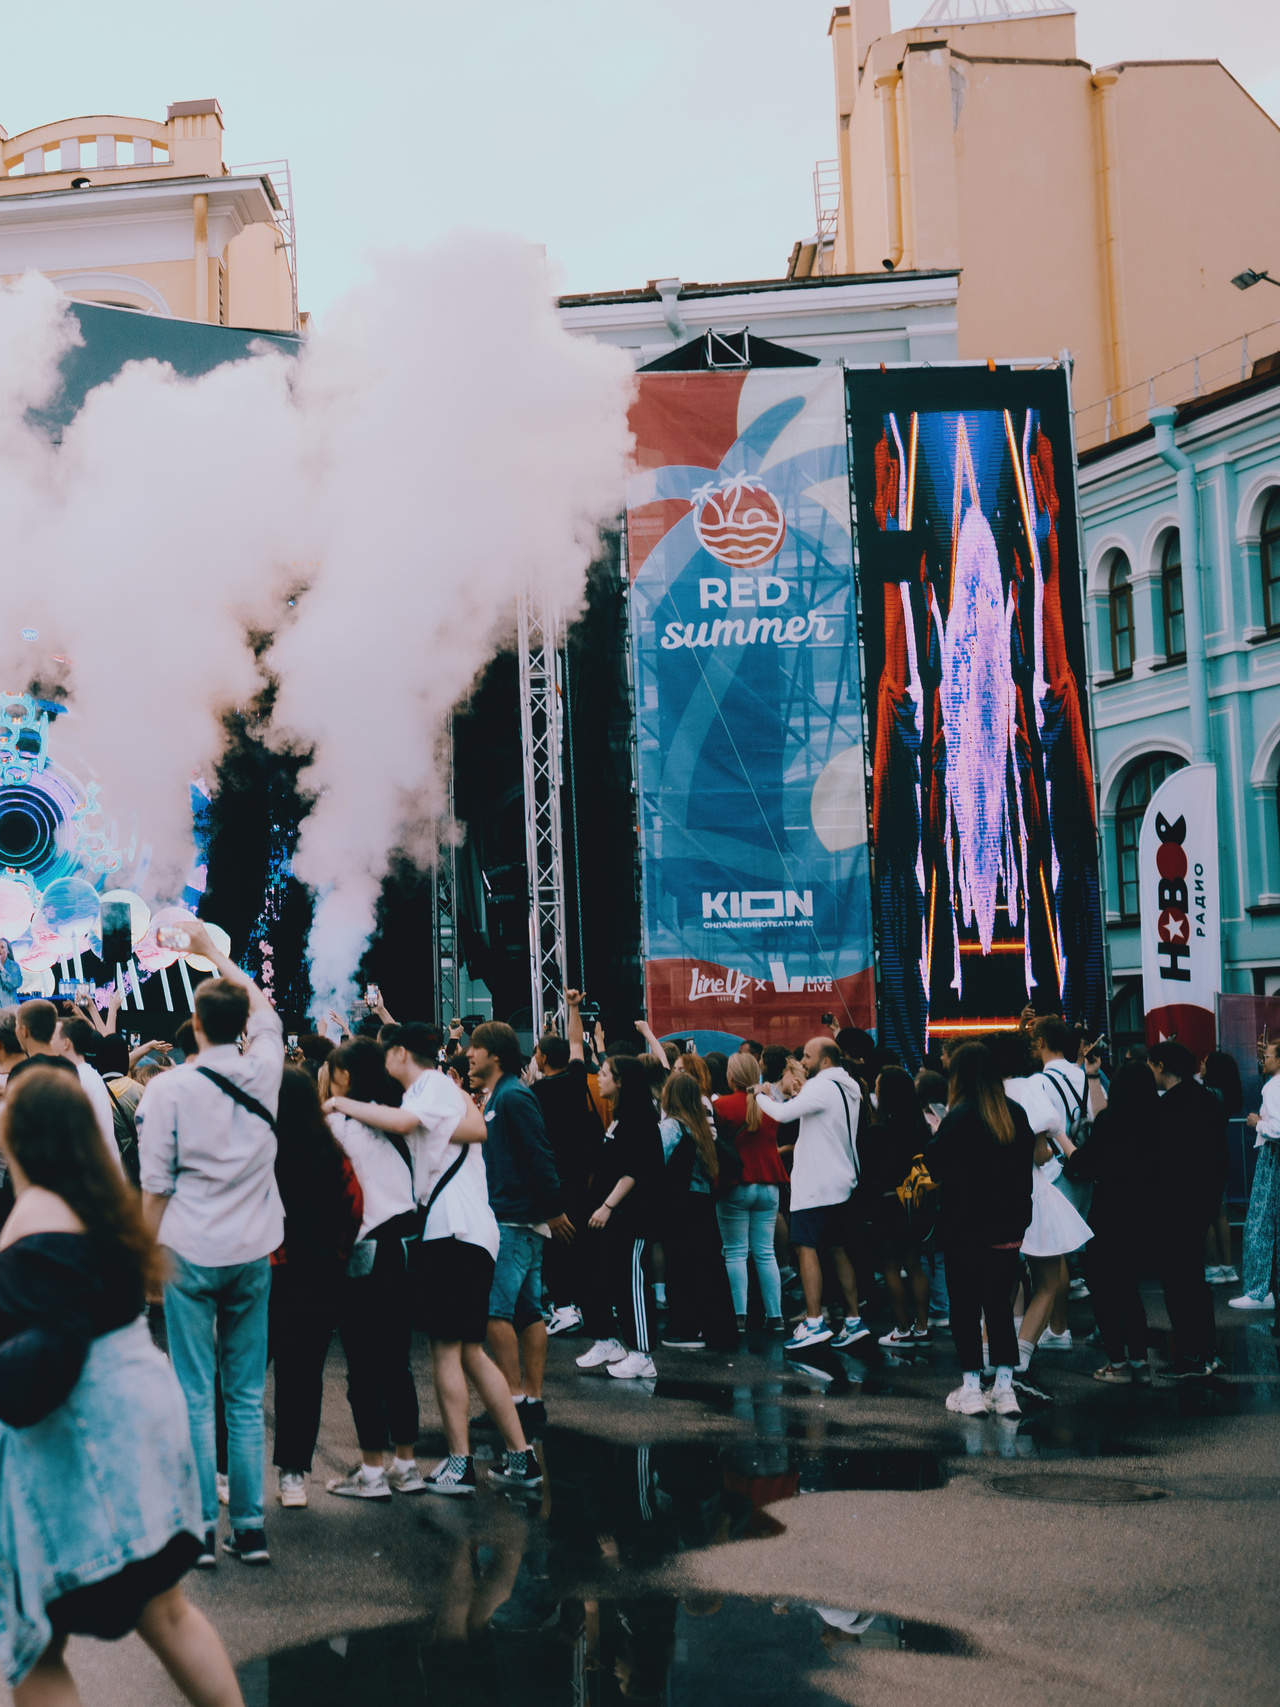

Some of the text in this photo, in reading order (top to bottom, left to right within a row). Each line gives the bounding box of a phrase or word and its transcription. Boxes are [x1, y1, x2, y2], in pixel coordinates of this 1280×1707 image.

[699, 576, 790, 609] RED
[660, 610, 834, 650] summer
[702, 890, 814, 918] KION
[1194, 862, 1206, 937] РАДИО
[807, 975, 833, 984] МТС
[807, 983, 833, 992] LIVE
